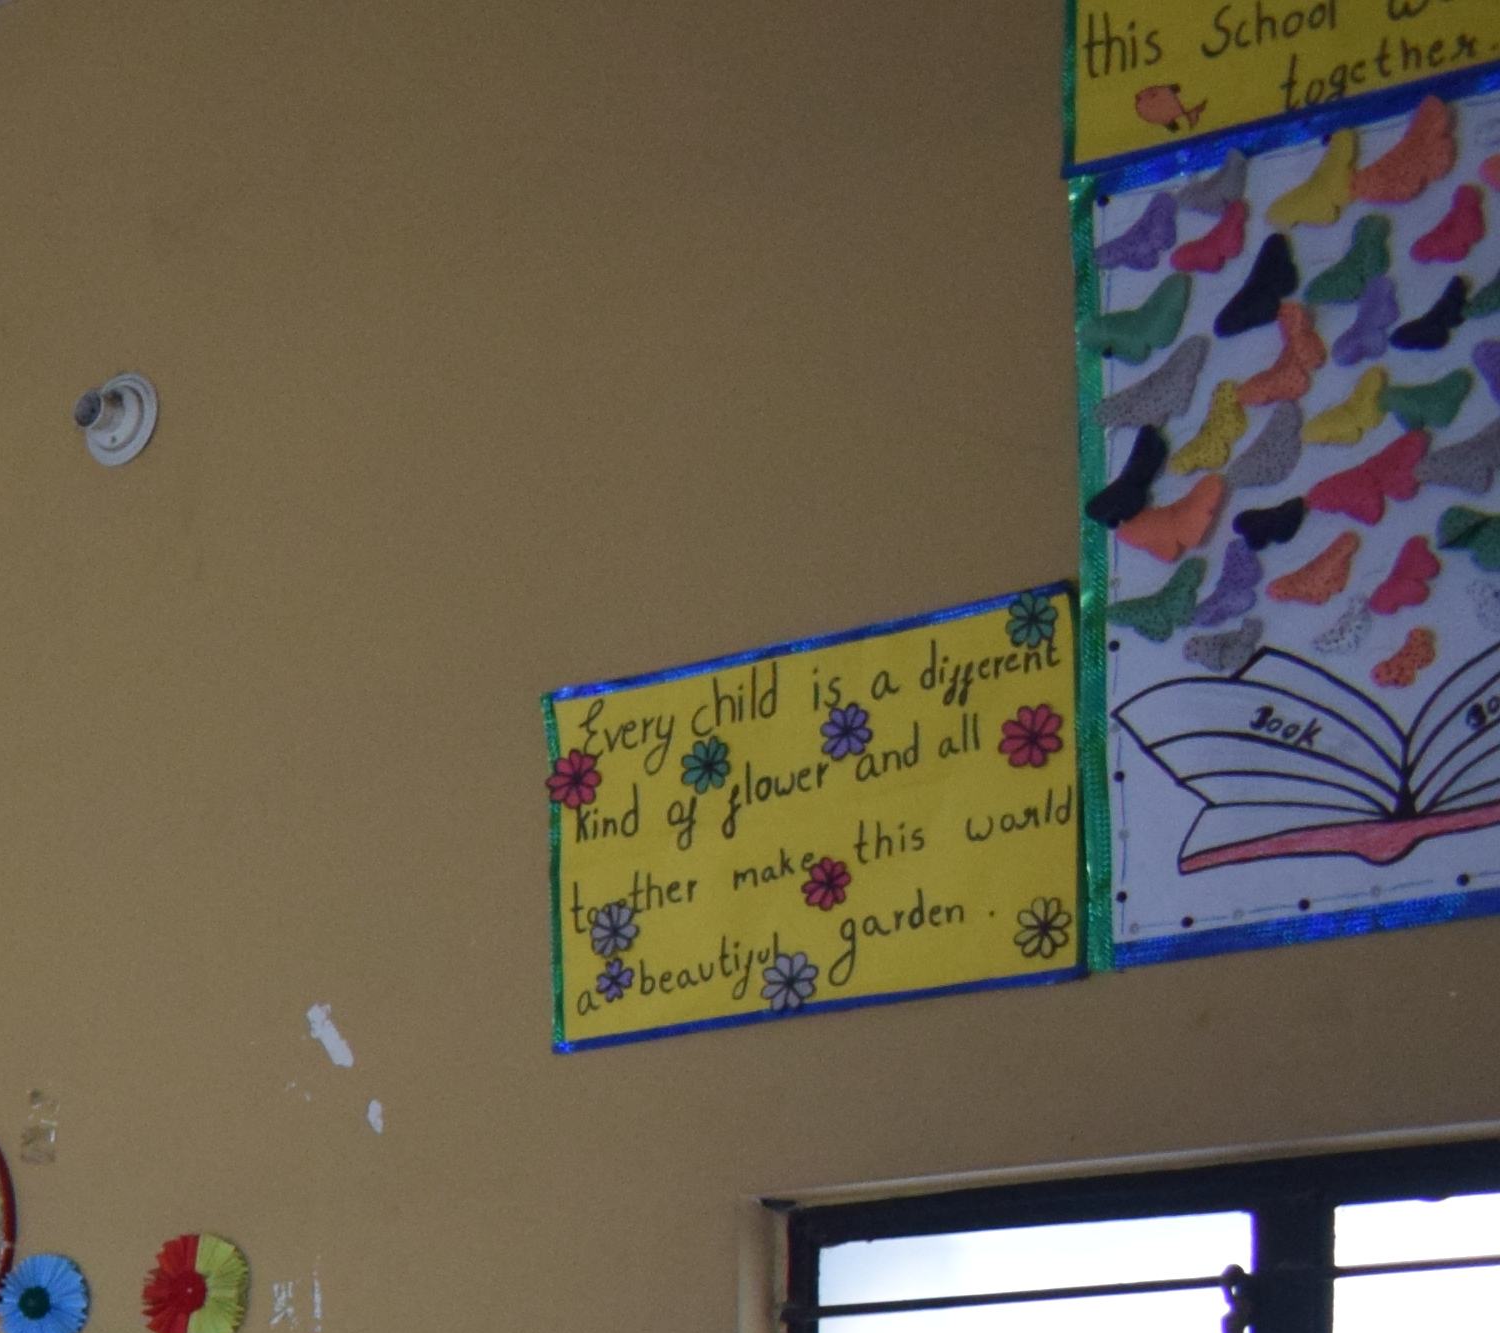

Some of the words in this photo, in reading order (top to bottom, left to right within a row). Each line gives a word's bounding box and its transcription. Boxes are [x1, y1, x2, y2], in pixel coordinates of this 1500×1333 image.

[1083, 12, 1163, 79] this
[578, 698, 675, 776] Every
[691, 661, 778, 737] child
[812, 668, 843, 712] is
[871, 670, 901, 700] a
[919, 638, 1061, 707] different
[667, 795, 697, 851] of
[721, 761, 829, 839] flower
[855, 721, 920, 782] and
[937, 712, 981, 758] all
[570, 870, 698, 934] tother
[733, 848, 814, 890] make
[853, 819, 926, 864] this
[576, 990, 600, 1016] a
[639, 931, 779, 1000] beautiful
